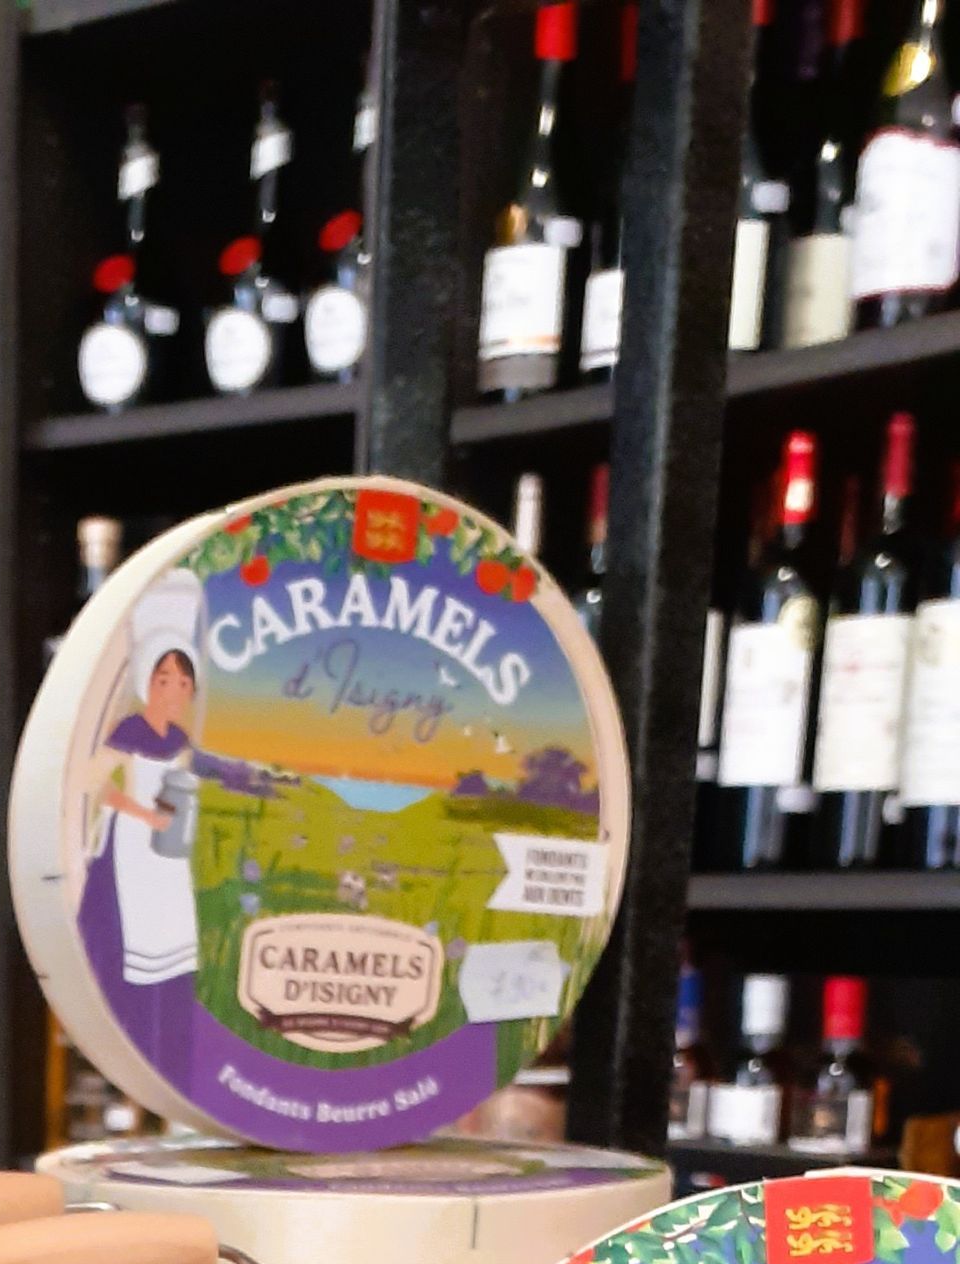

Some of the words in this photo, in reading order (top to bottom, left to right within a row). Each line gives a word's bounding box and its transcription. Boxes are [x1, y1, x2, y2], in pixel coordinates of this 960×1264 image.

[207, 574, 531, 704] CARAMELS
[259, 945, 424, 980] CARAMELS
[284, 980, 398, 1007] D'ISIGNY
[218, 1064, 312, 1121] Fondants
[317, 1099, 390, 1123] Beurre
